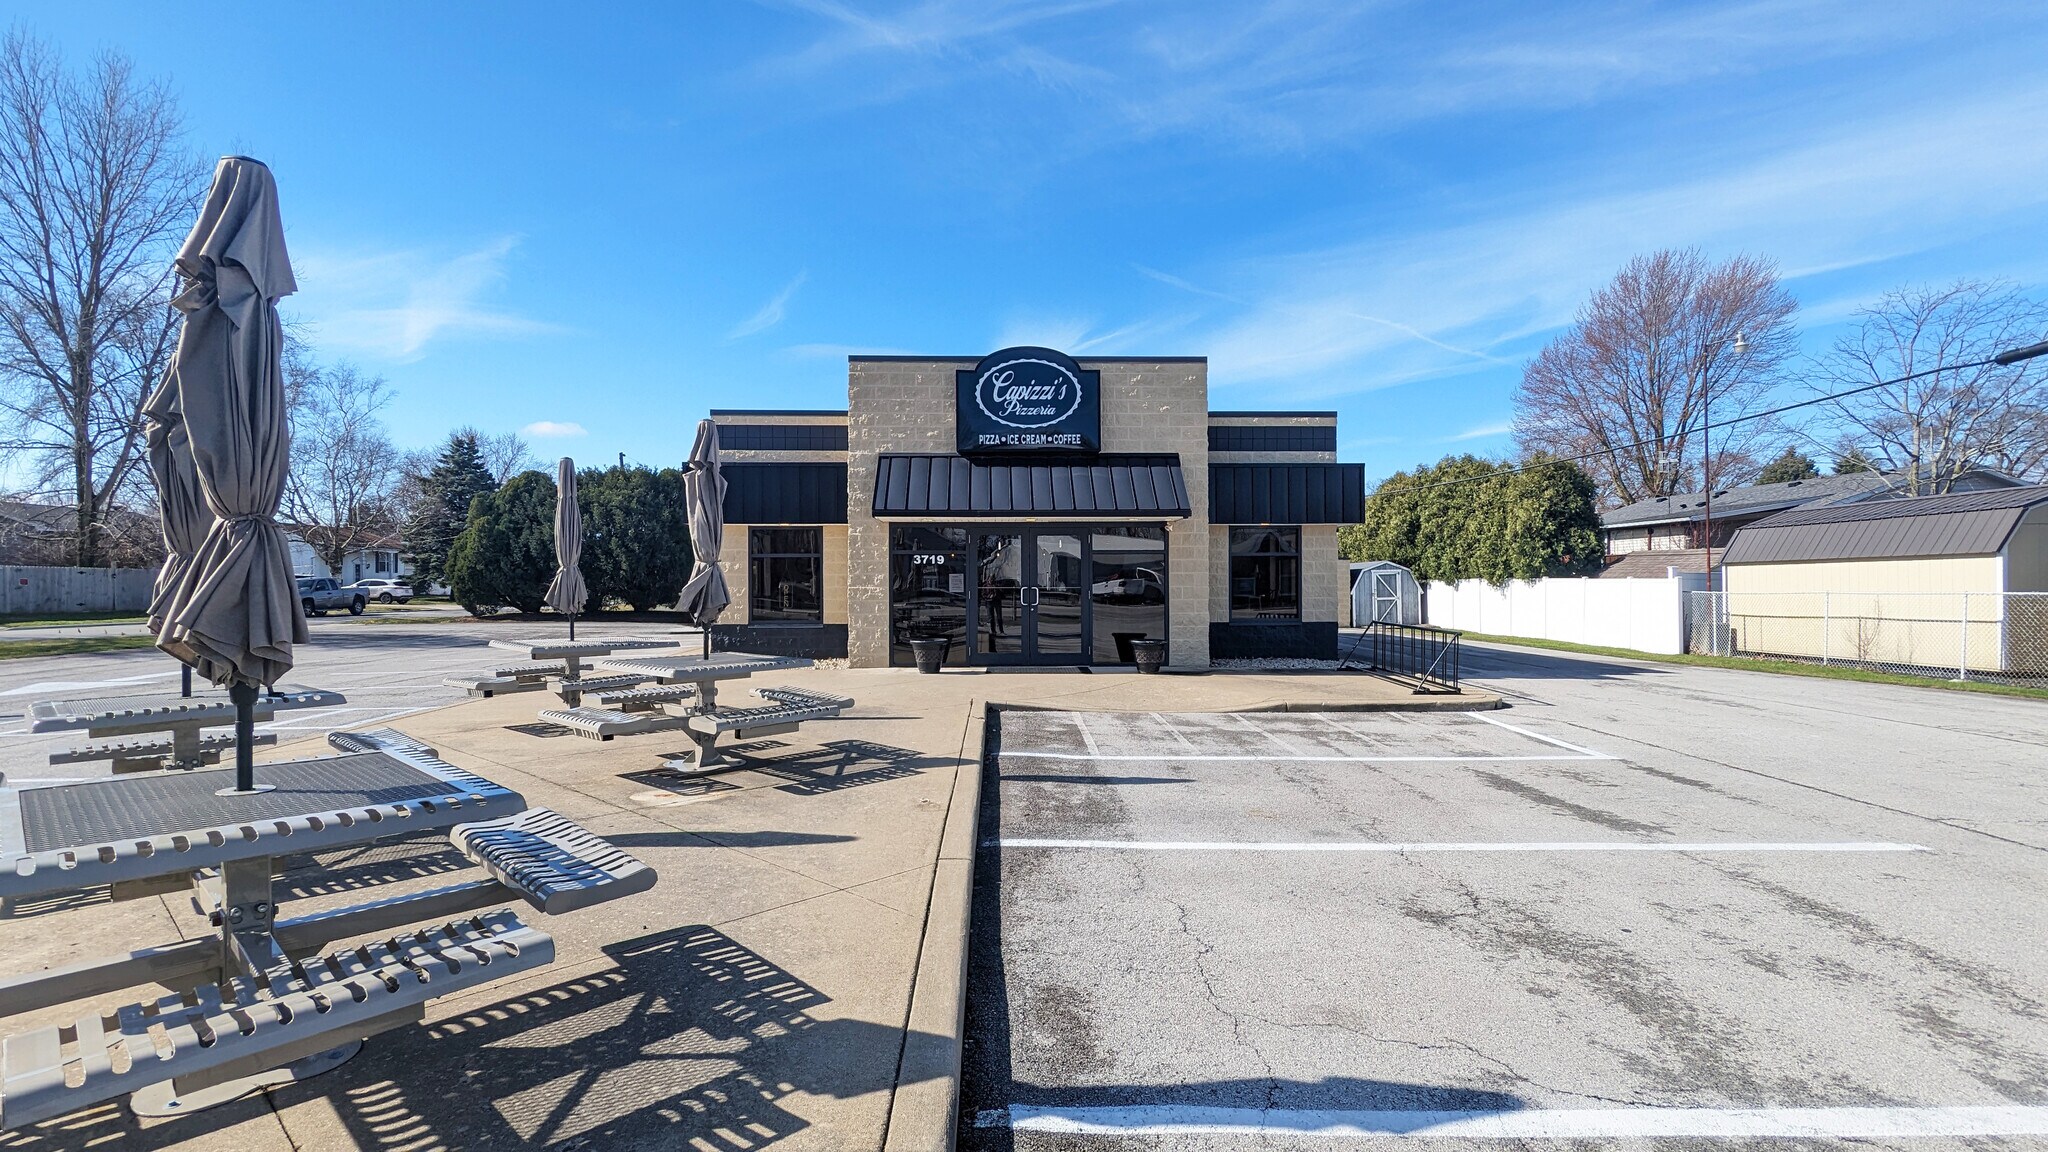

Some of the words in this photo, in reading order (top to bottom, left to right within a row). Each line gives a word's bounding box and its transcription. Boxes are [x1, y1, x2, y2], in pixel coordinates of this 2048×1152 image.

[992, 370, 1068, 403] Capizzi's
[999, 400, 1056, 417] Pizzeria
[978, 434, 1000, 445] PIZZA
[1007, 434, 1019, 445] ICE
[1021, 434, 1047, 445] CREAM
[1053, 434, 1081, 445] COFFEE
[913, 554, 945, 565] 3719
